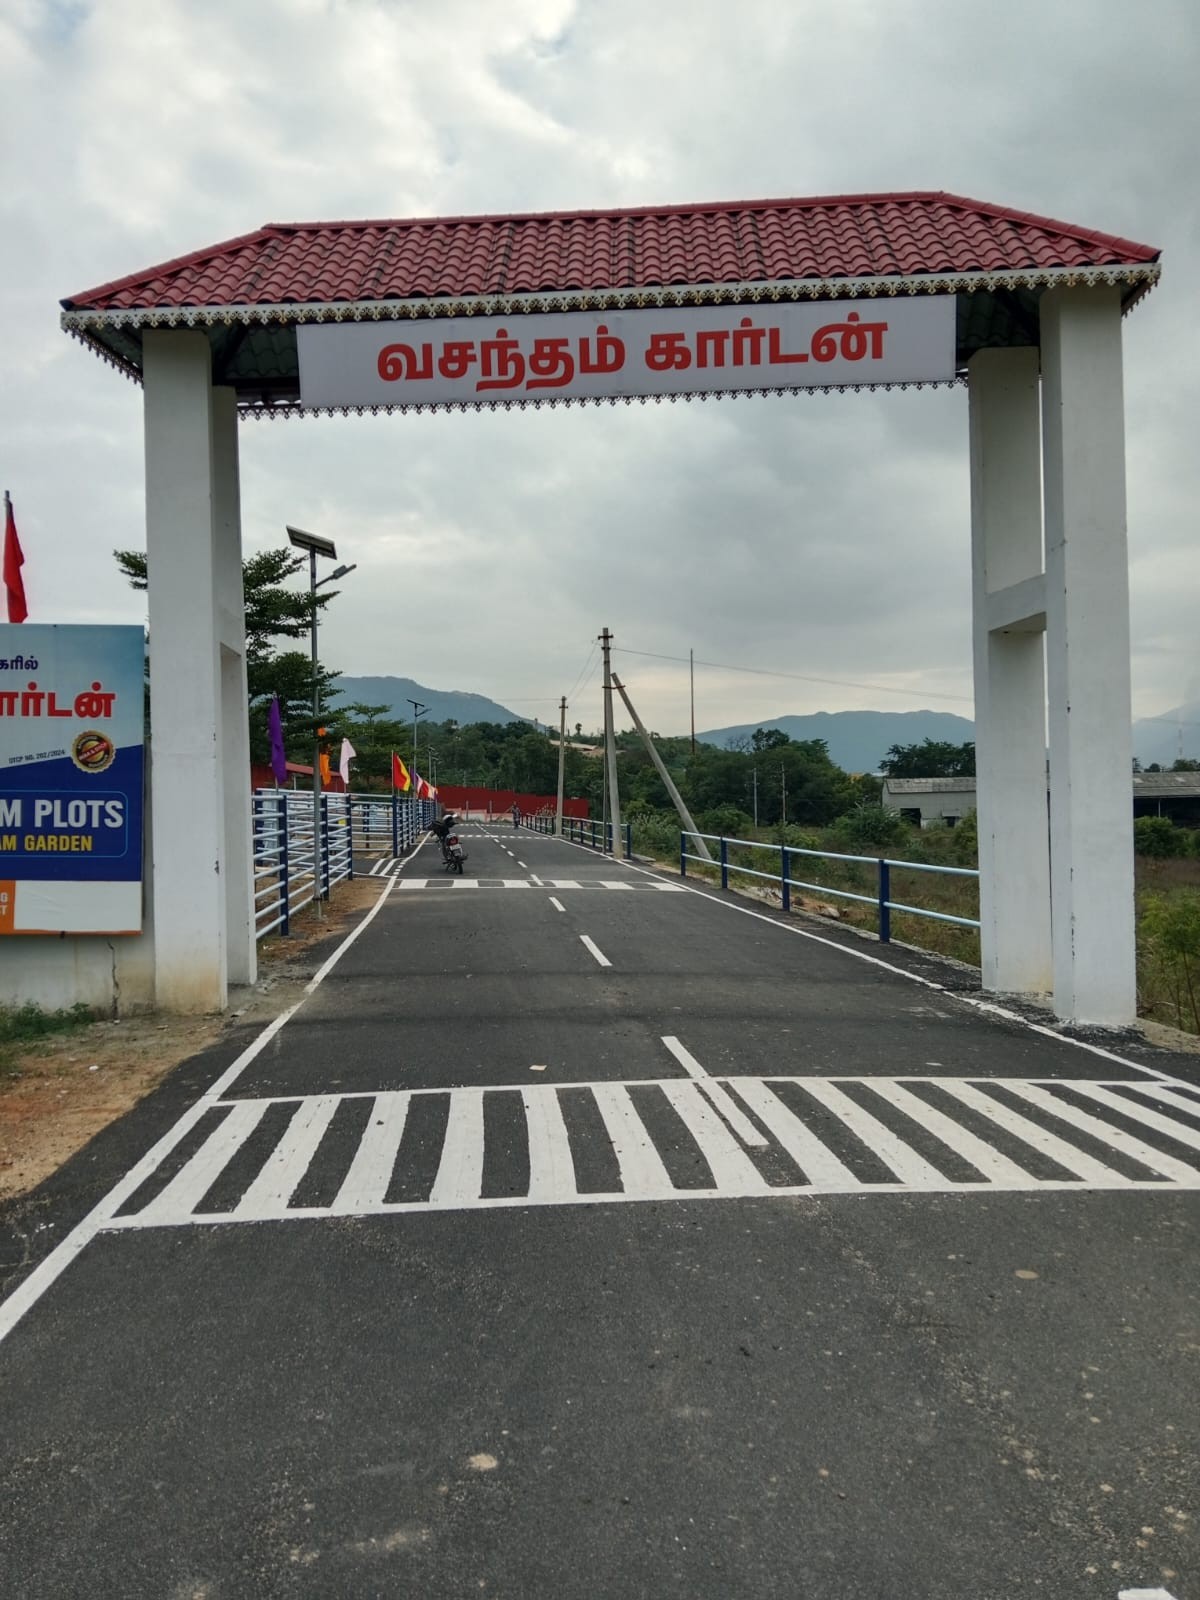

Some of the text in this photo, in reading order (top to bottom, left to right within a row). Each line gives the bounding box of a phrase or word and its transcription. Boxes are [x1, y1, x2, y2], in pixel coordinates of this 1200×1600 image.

[377, 311, 889, 392] வசந்தம் கார்டன்
[34, 799, 124, 828] PLOTS
[0, 835, 92, 851] M GARDEN
